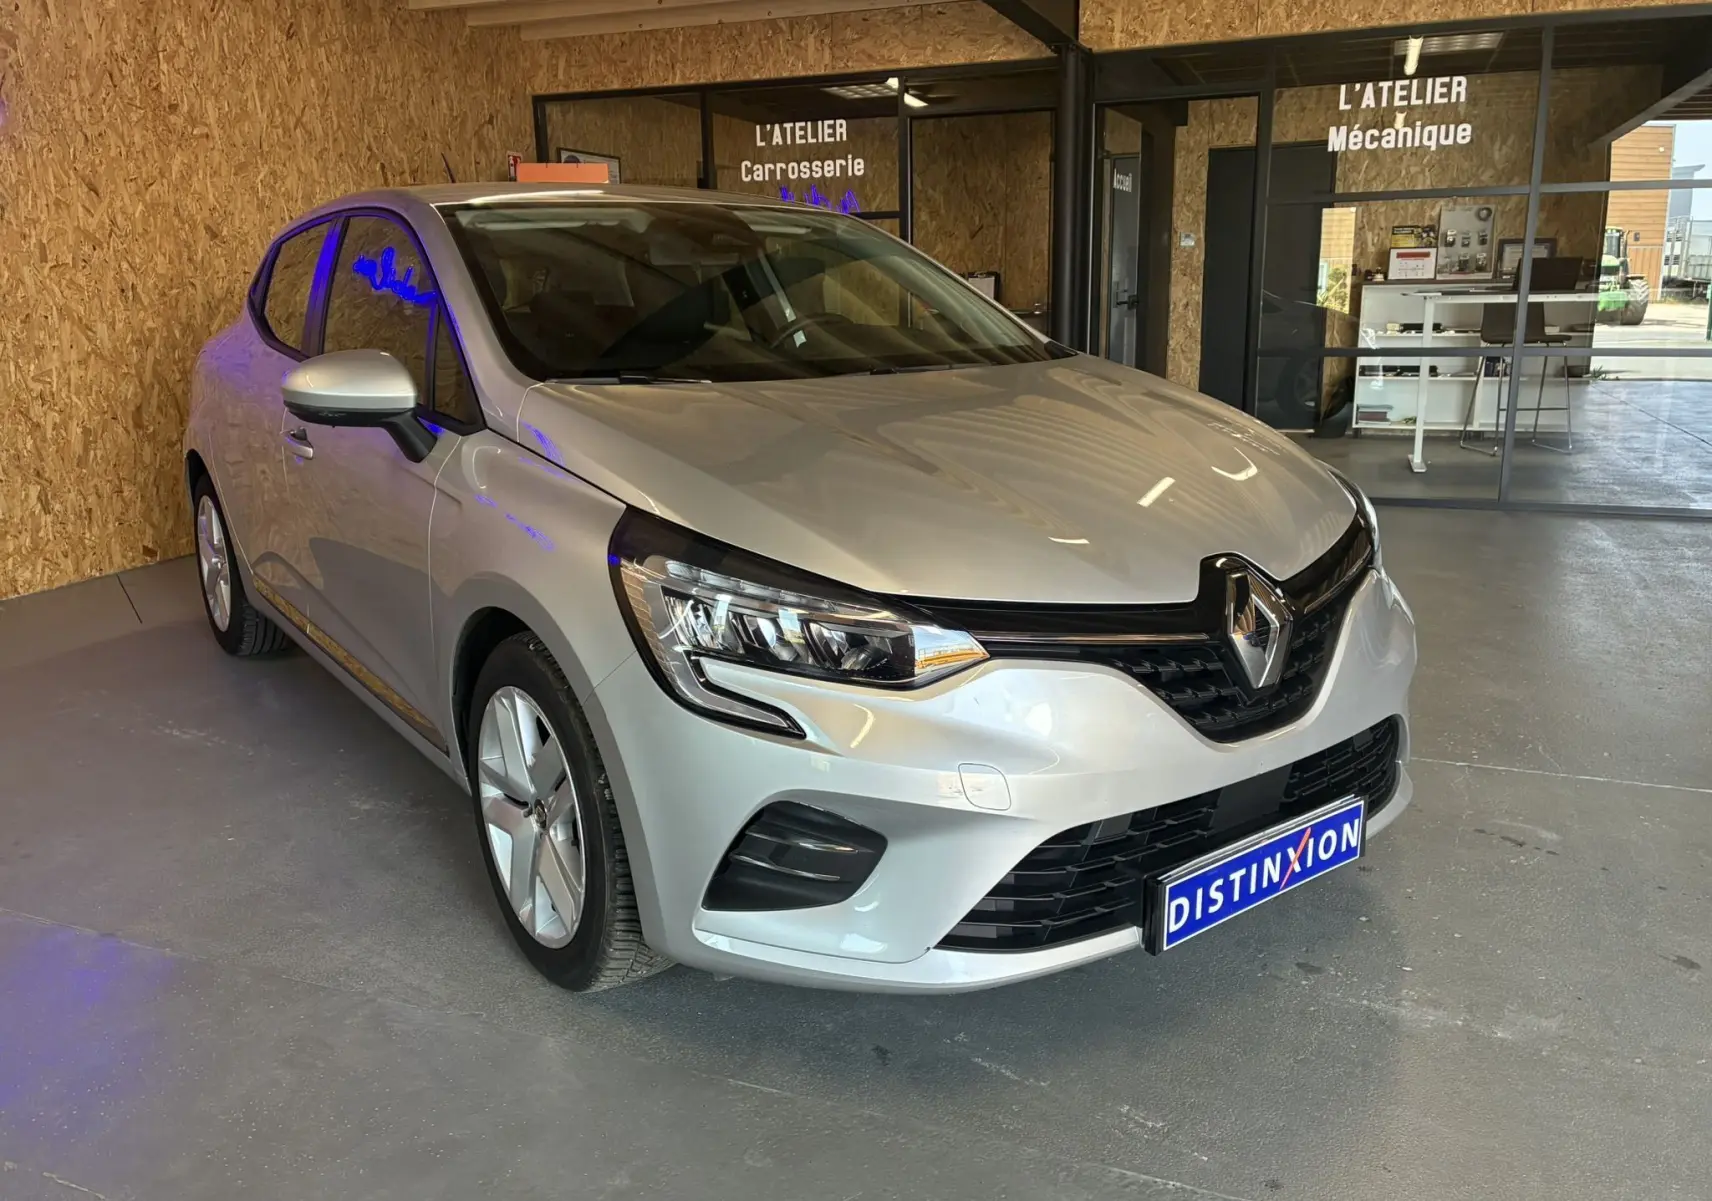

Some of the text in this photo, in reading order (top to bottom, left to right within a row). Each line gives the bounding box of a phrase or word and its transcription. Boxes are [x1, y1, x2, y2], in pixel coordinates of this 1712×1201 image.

[1339, 76, 1467, 110] L'ATELIER
[755, 119, 847, 147] L'ATELIER
[1328, 121, 1472, 152] Mécanique
[740, 154, 864, 182] Carrosserie
[1113, 168, 1132, 193] Accueil
[1169, 818, 1359, 933] DISTINXION
